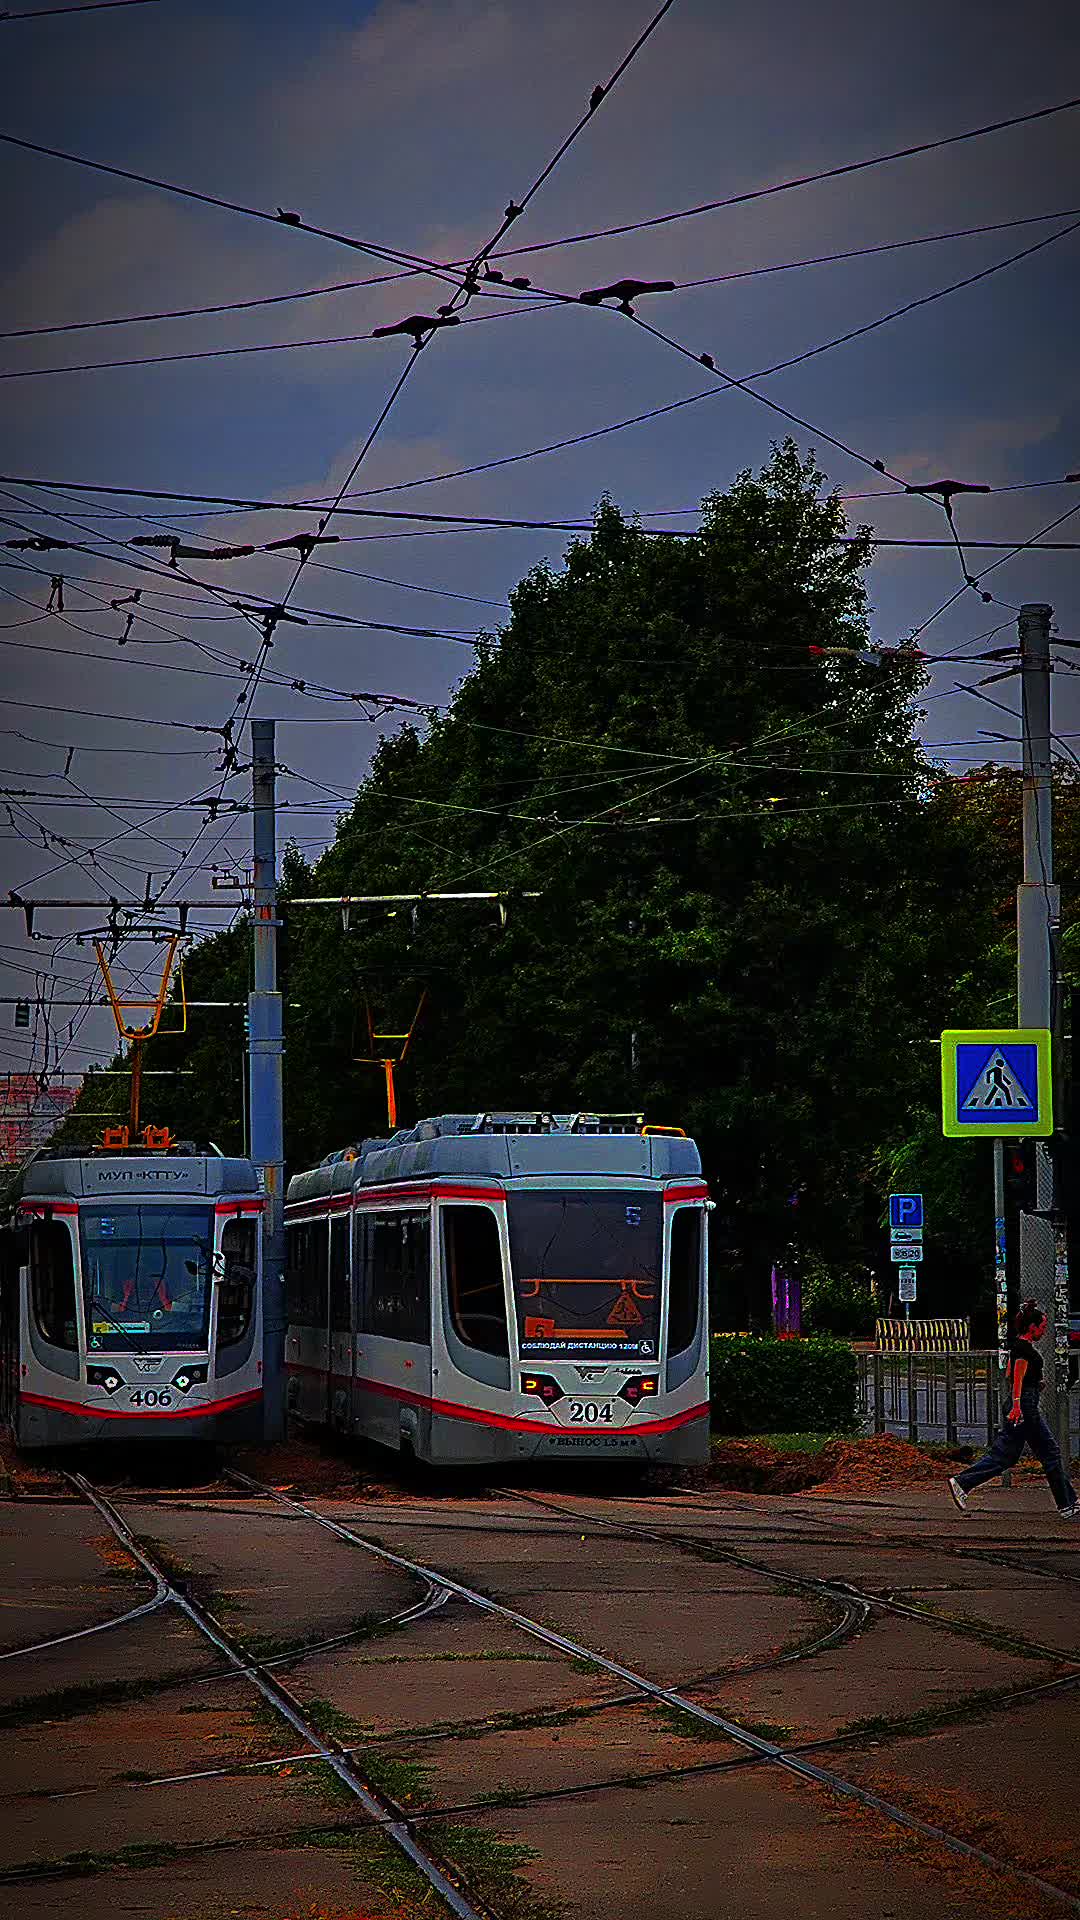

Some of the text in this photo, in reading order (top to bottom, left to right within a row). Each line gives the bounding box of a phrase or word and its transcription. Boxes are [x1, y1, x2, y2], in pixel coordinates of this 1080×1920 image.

[98, 1171, 133, 1181] МУП
[899, 1198, 917, 1224] P
[521, 1341, 566, 1351] СОБЛЮДАЙ
[567, 1341, 618, 1351] ДИСТАНЦИЮ
[129, 1389, 172, 1407] 406
[569, 1402, 613, 1423] 204
[557, 1437, 601, 1447] ВЫНОС
